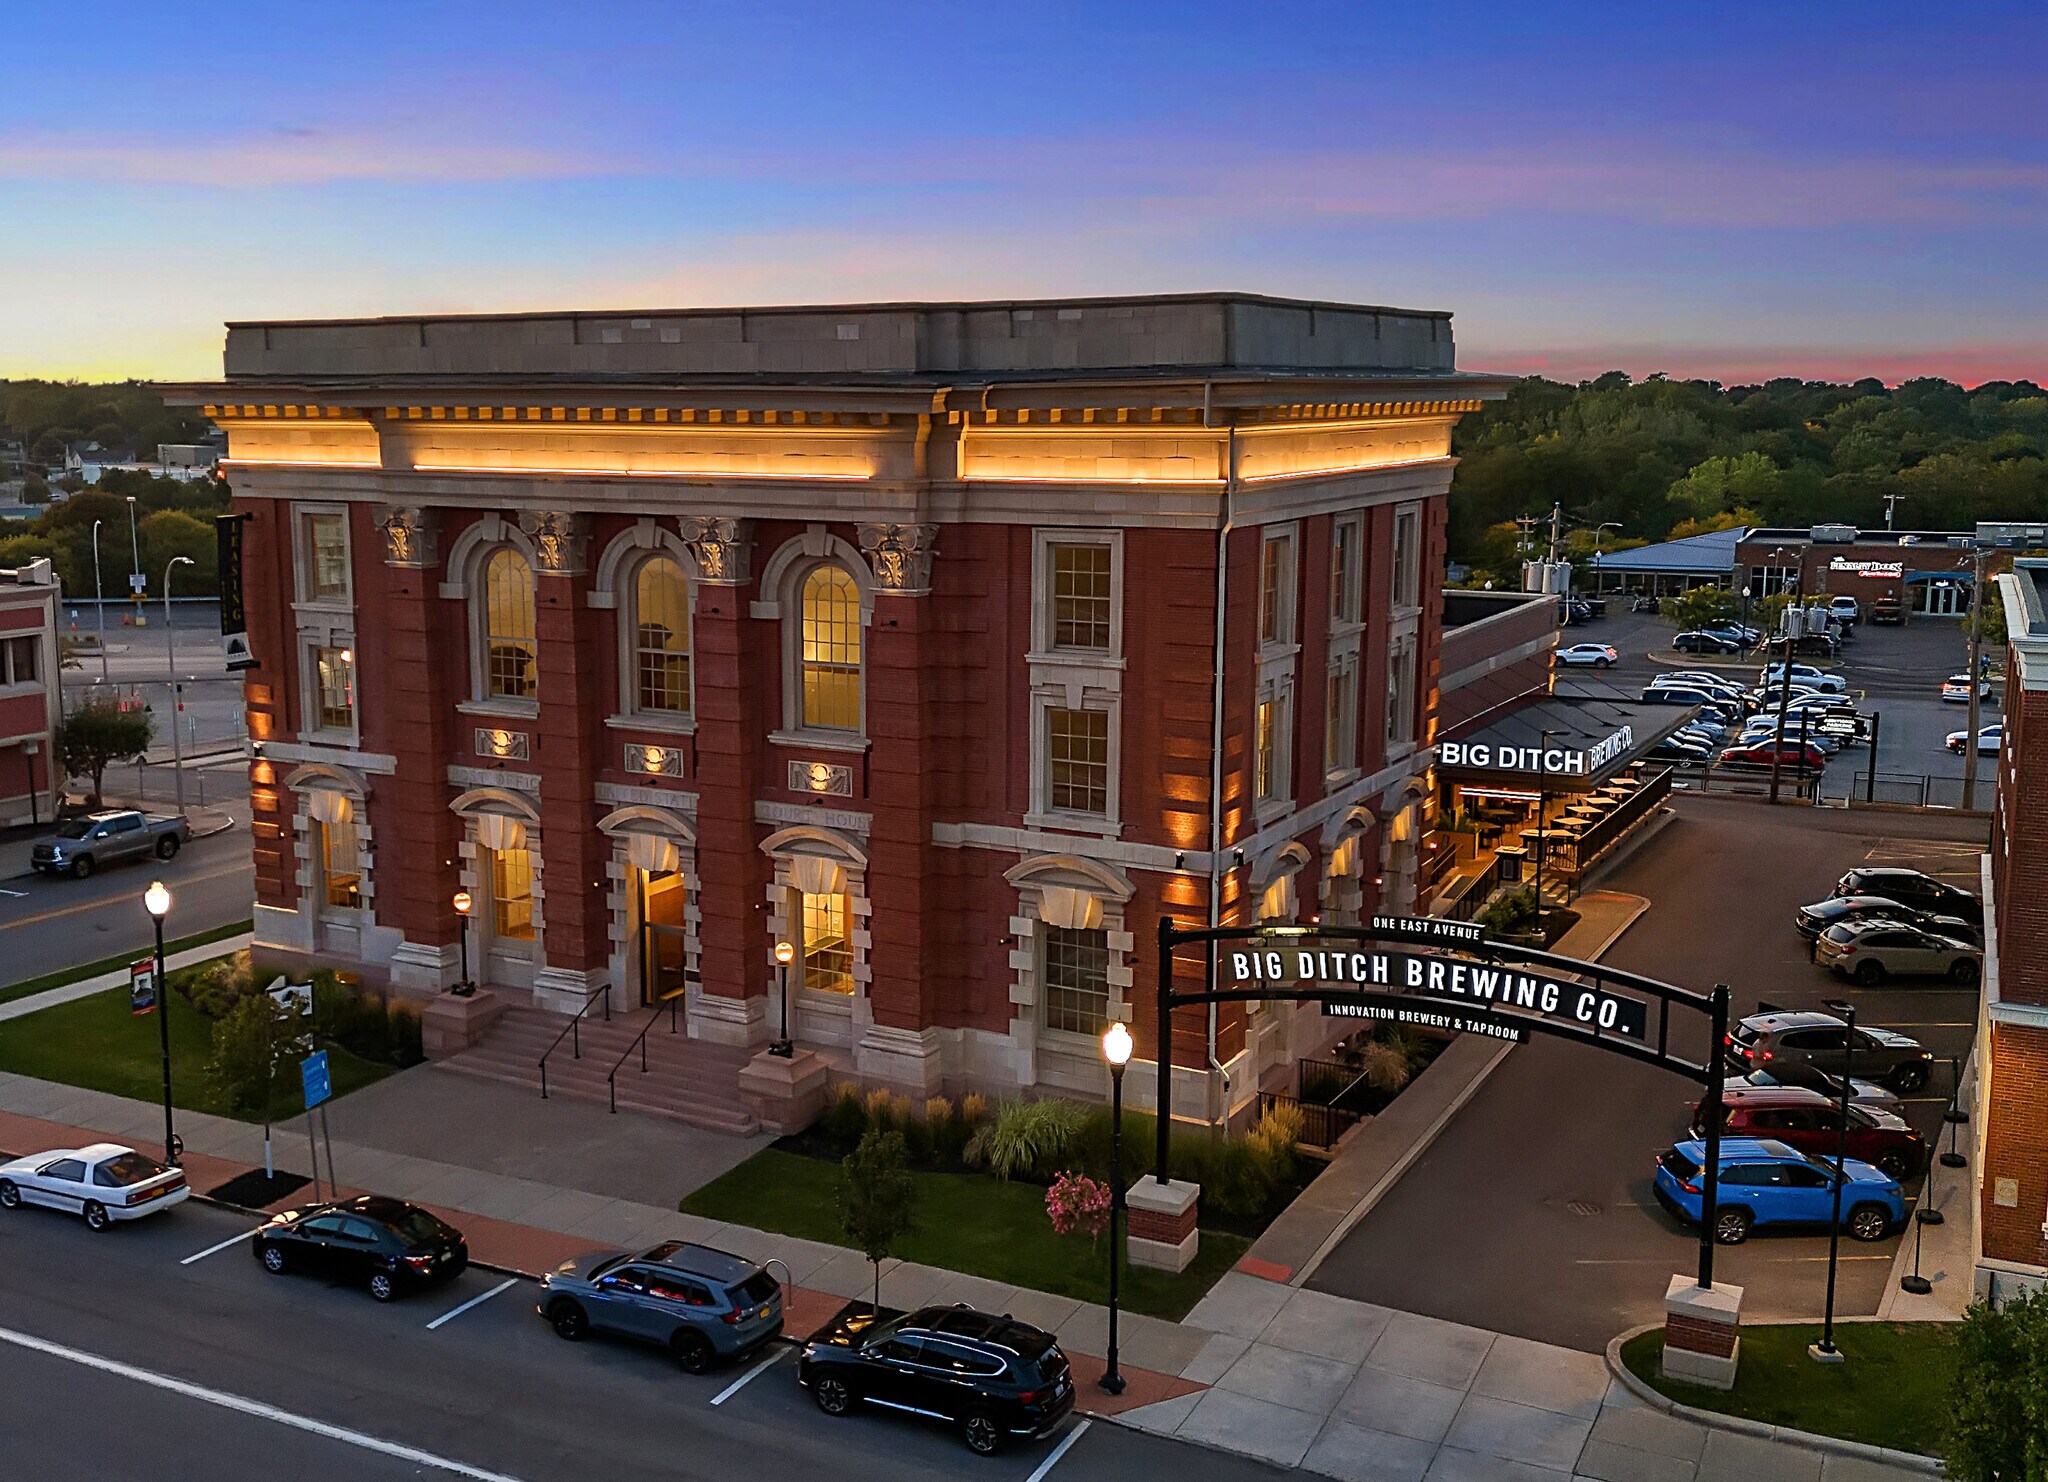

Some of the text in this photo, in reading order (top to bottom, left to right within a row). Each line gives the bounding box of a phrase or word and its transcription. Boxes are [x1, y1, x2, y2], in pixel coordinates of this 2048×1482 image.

[1442, 742, 1490, 766] BIG
[1498, 746, 1584, 773] DITCH
[1588, 732, 1622, 771] BREWING
[825, 811, 868, 829] HOUS
[1373, 916, 1480, 941] ONE EAST AVENUE
[1232, 952, 1630, 1033] BIG DITCH BREWING CO.
[1329, 1004, 1520, 1041] INNOVATION BREWERY & TAPROOM
